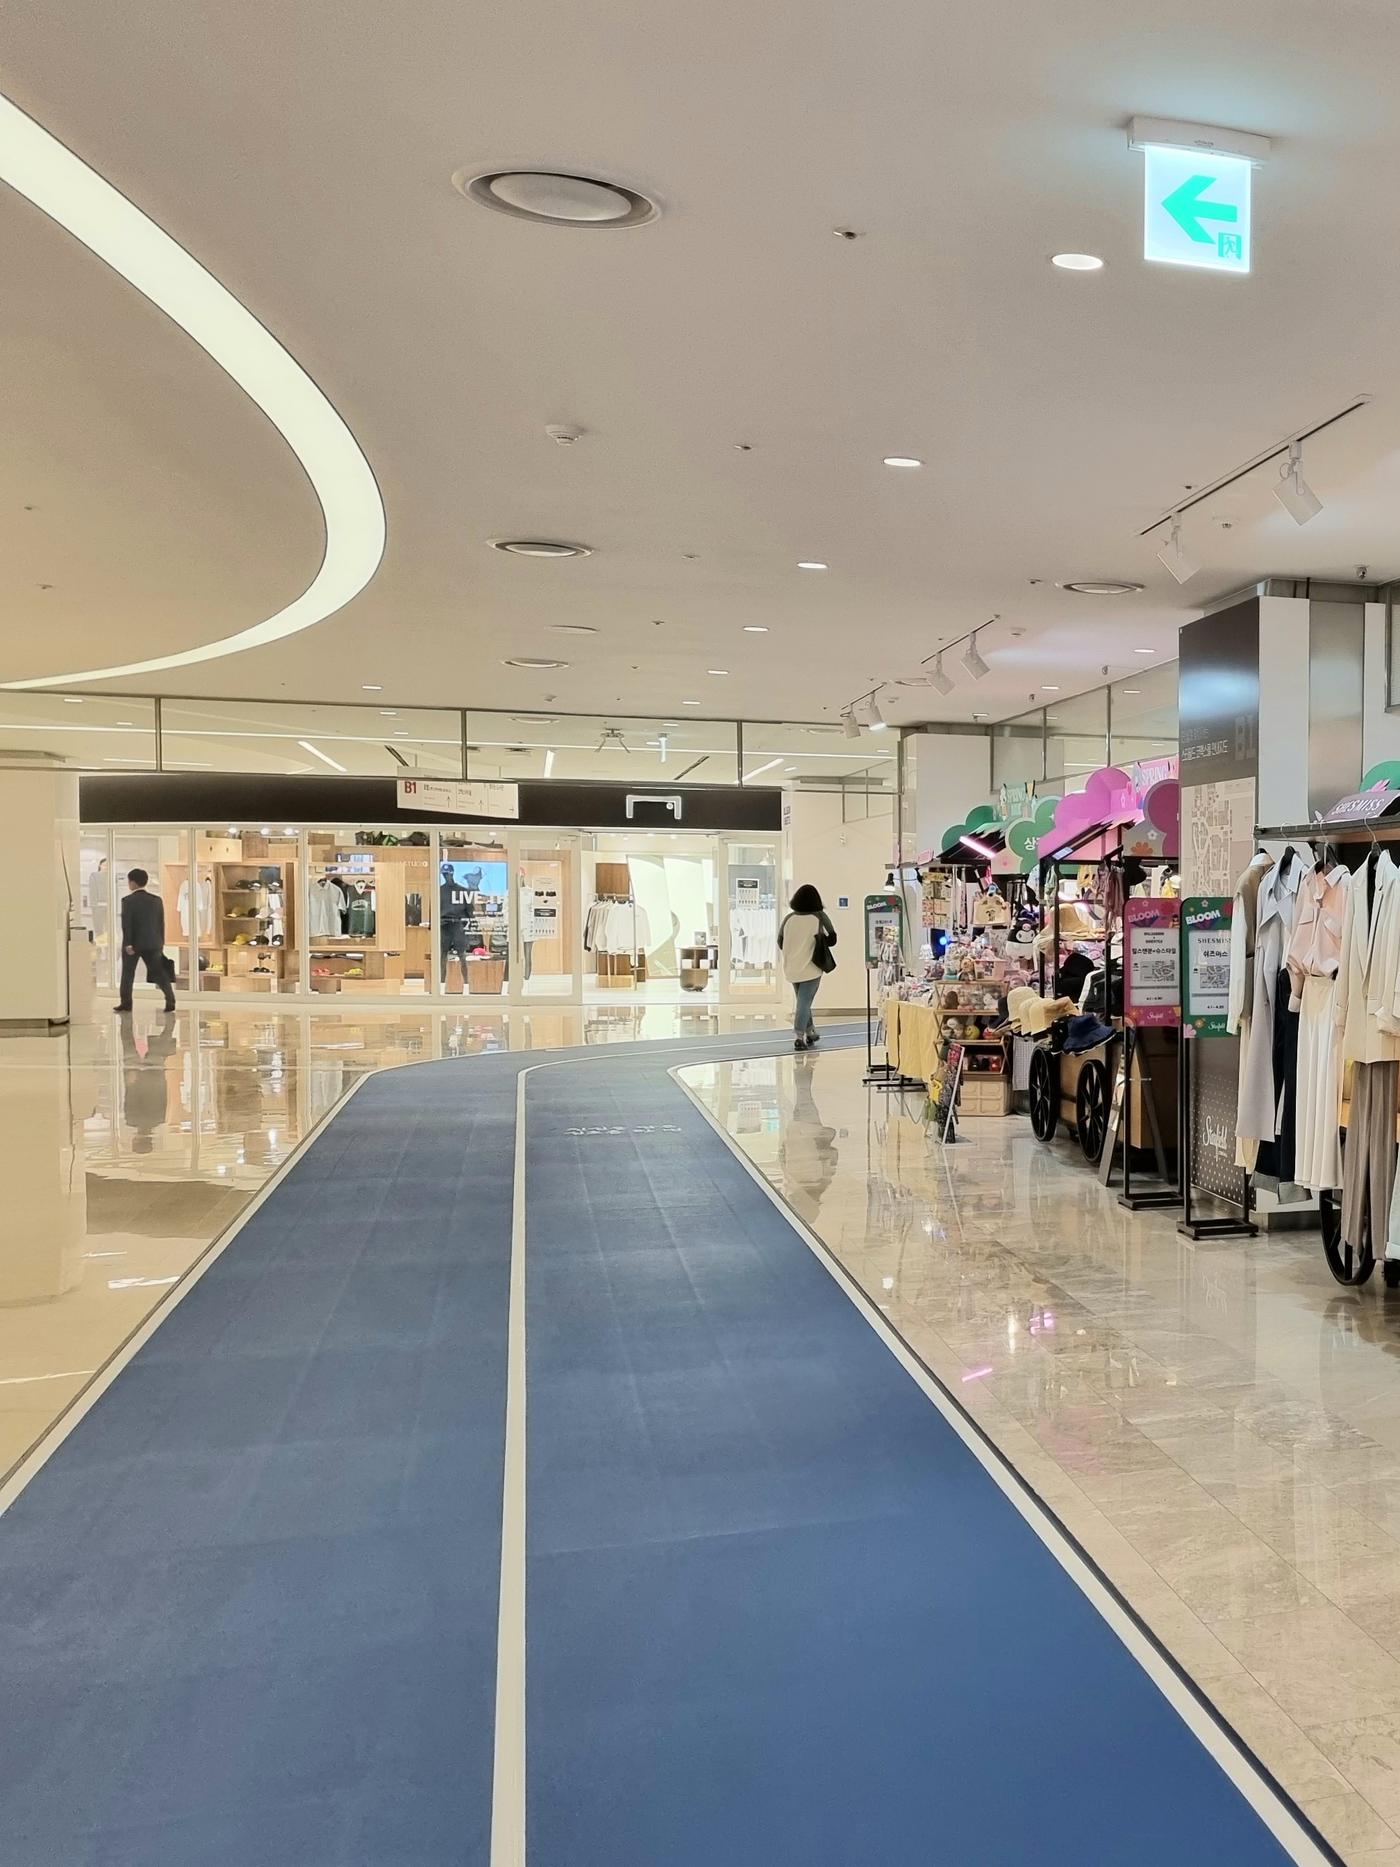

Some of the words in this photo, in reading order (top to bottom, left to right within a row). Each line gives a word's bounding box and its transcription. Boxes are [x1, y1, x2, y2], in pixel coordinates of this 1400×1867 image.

[404, 781, 417, 794] B1
[1128, 909, 1160, 923] BLOOM
[1185, 909, 1221, 925] BLOOM
